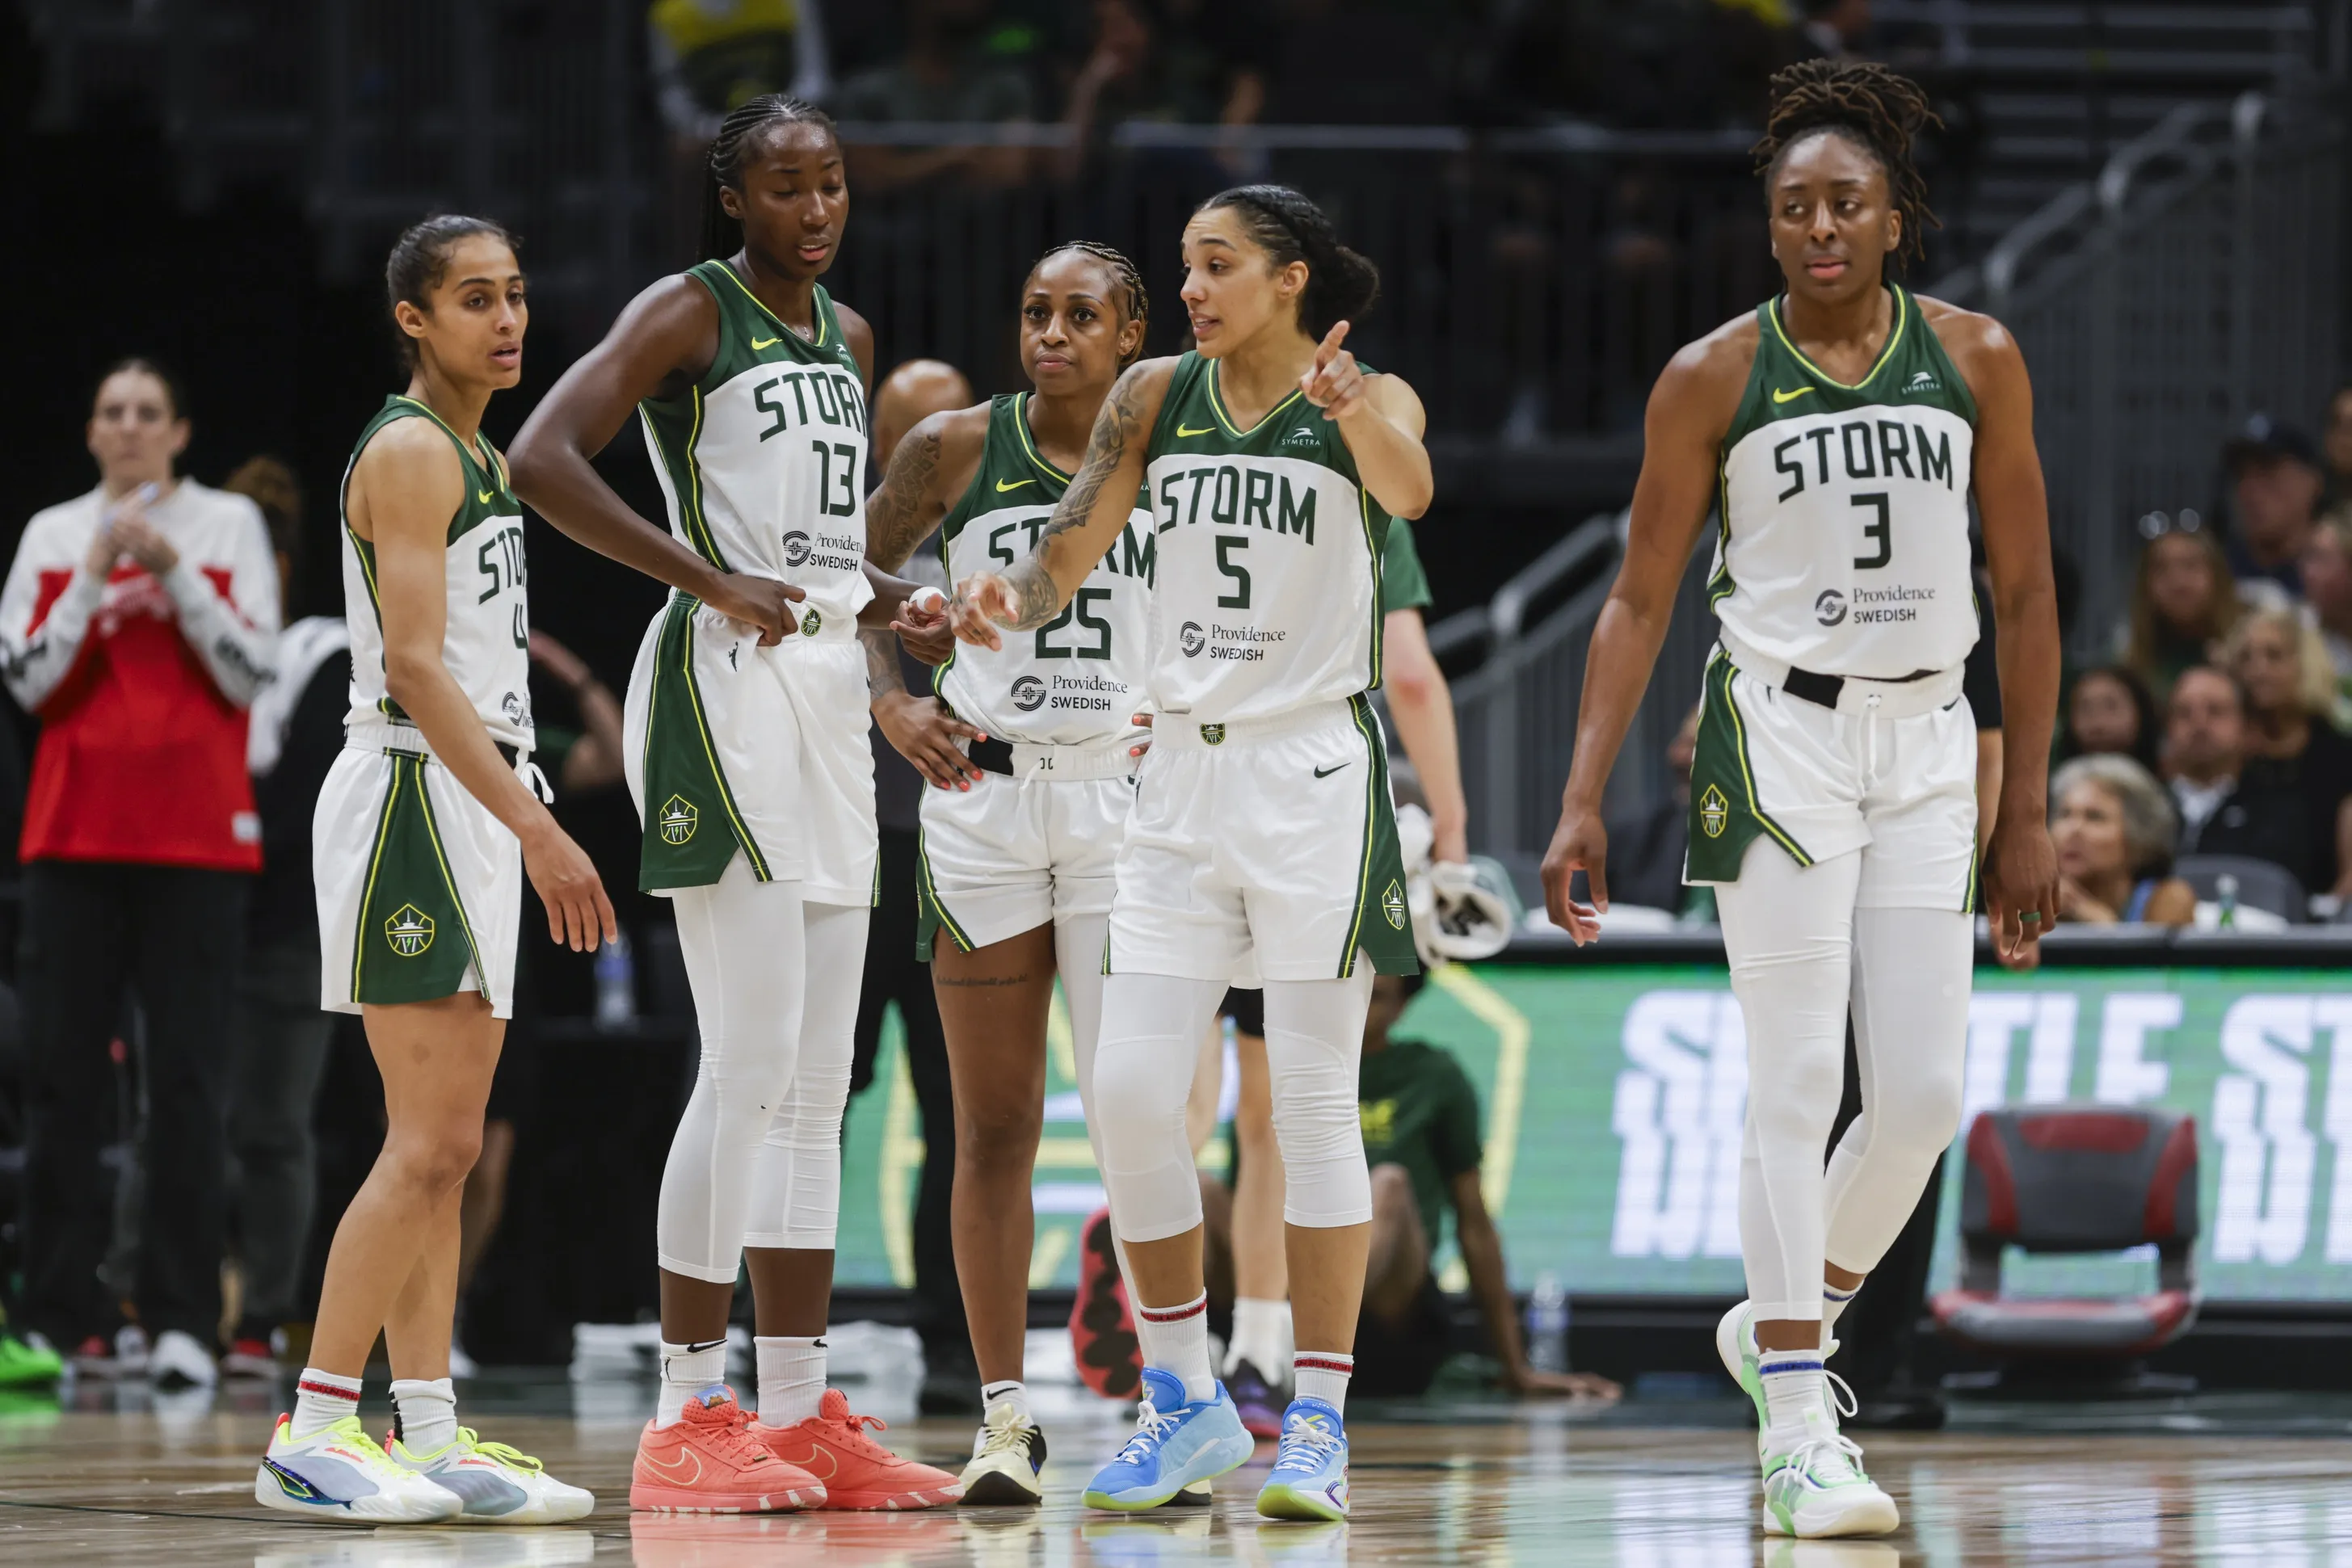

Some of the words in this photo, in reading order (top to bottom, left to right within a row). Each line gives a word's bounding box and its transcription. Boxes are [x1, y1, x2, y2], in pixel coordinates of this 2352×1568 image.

[1281, 438, 1321, 446] SYMETRA
[1773, 419, 1954, 504] STORM
[812, 439, 856, 518] 13
[1158, 465, 1317, 546] STORM
[1849, 490, 1892, 570] 3
[809, 553, 858, 572] SWEDISH
[1214, 535, 1252, 610] 5
[1853, 584, 1936, 603] Providence
[1035, 587, 1113, 661] 25
[1853, 607, 1917, 624] SWEDISH
[1211, 624, 1286, 642] Providence
[1210, 645, 1264, 662] SWEDISH
[1051, 675, 1128, 694] Providence
[1050, 696, 1111, 711] SWEDISH
